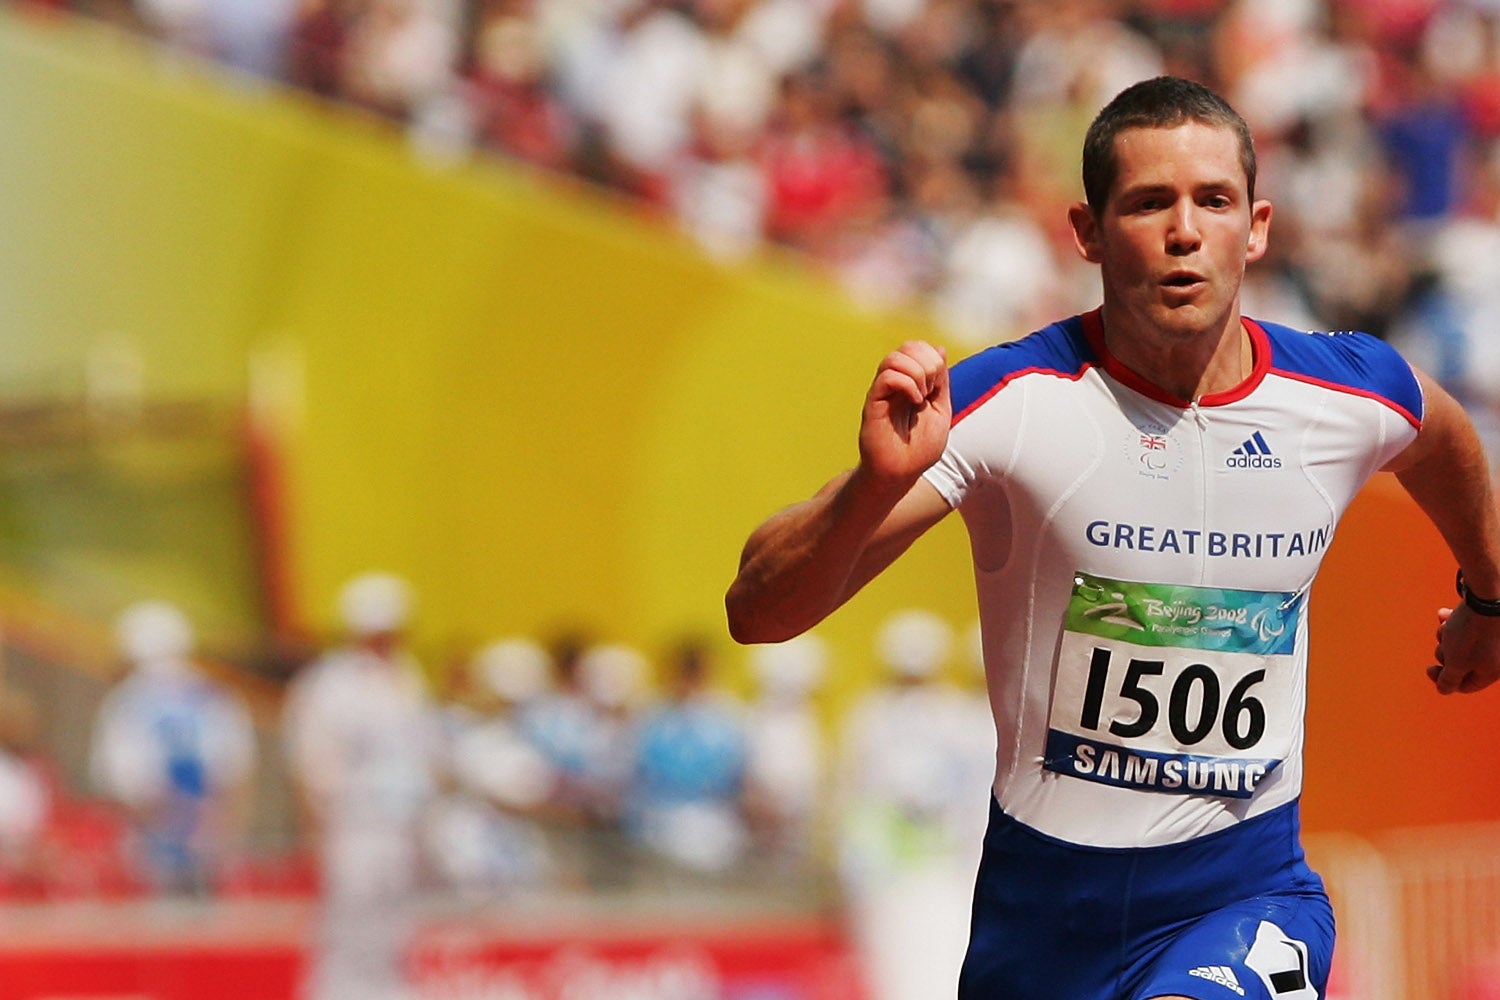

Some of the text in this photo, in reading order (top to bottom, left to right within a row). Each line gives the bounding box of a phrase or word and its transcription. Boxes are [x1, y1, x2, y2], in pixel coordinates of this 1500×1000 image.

[1226, 453, 1282, 468] adidas
[1086, 520, 1330, 558] GREAT BRITAIN
[1142, 598, 1248, 625] Beijing 2008
[1080, 647, 1267, 751] 1506
[1073, 744, 1267, 792] SAMSUNG
[1188, 969, 1246, 997] adidas
